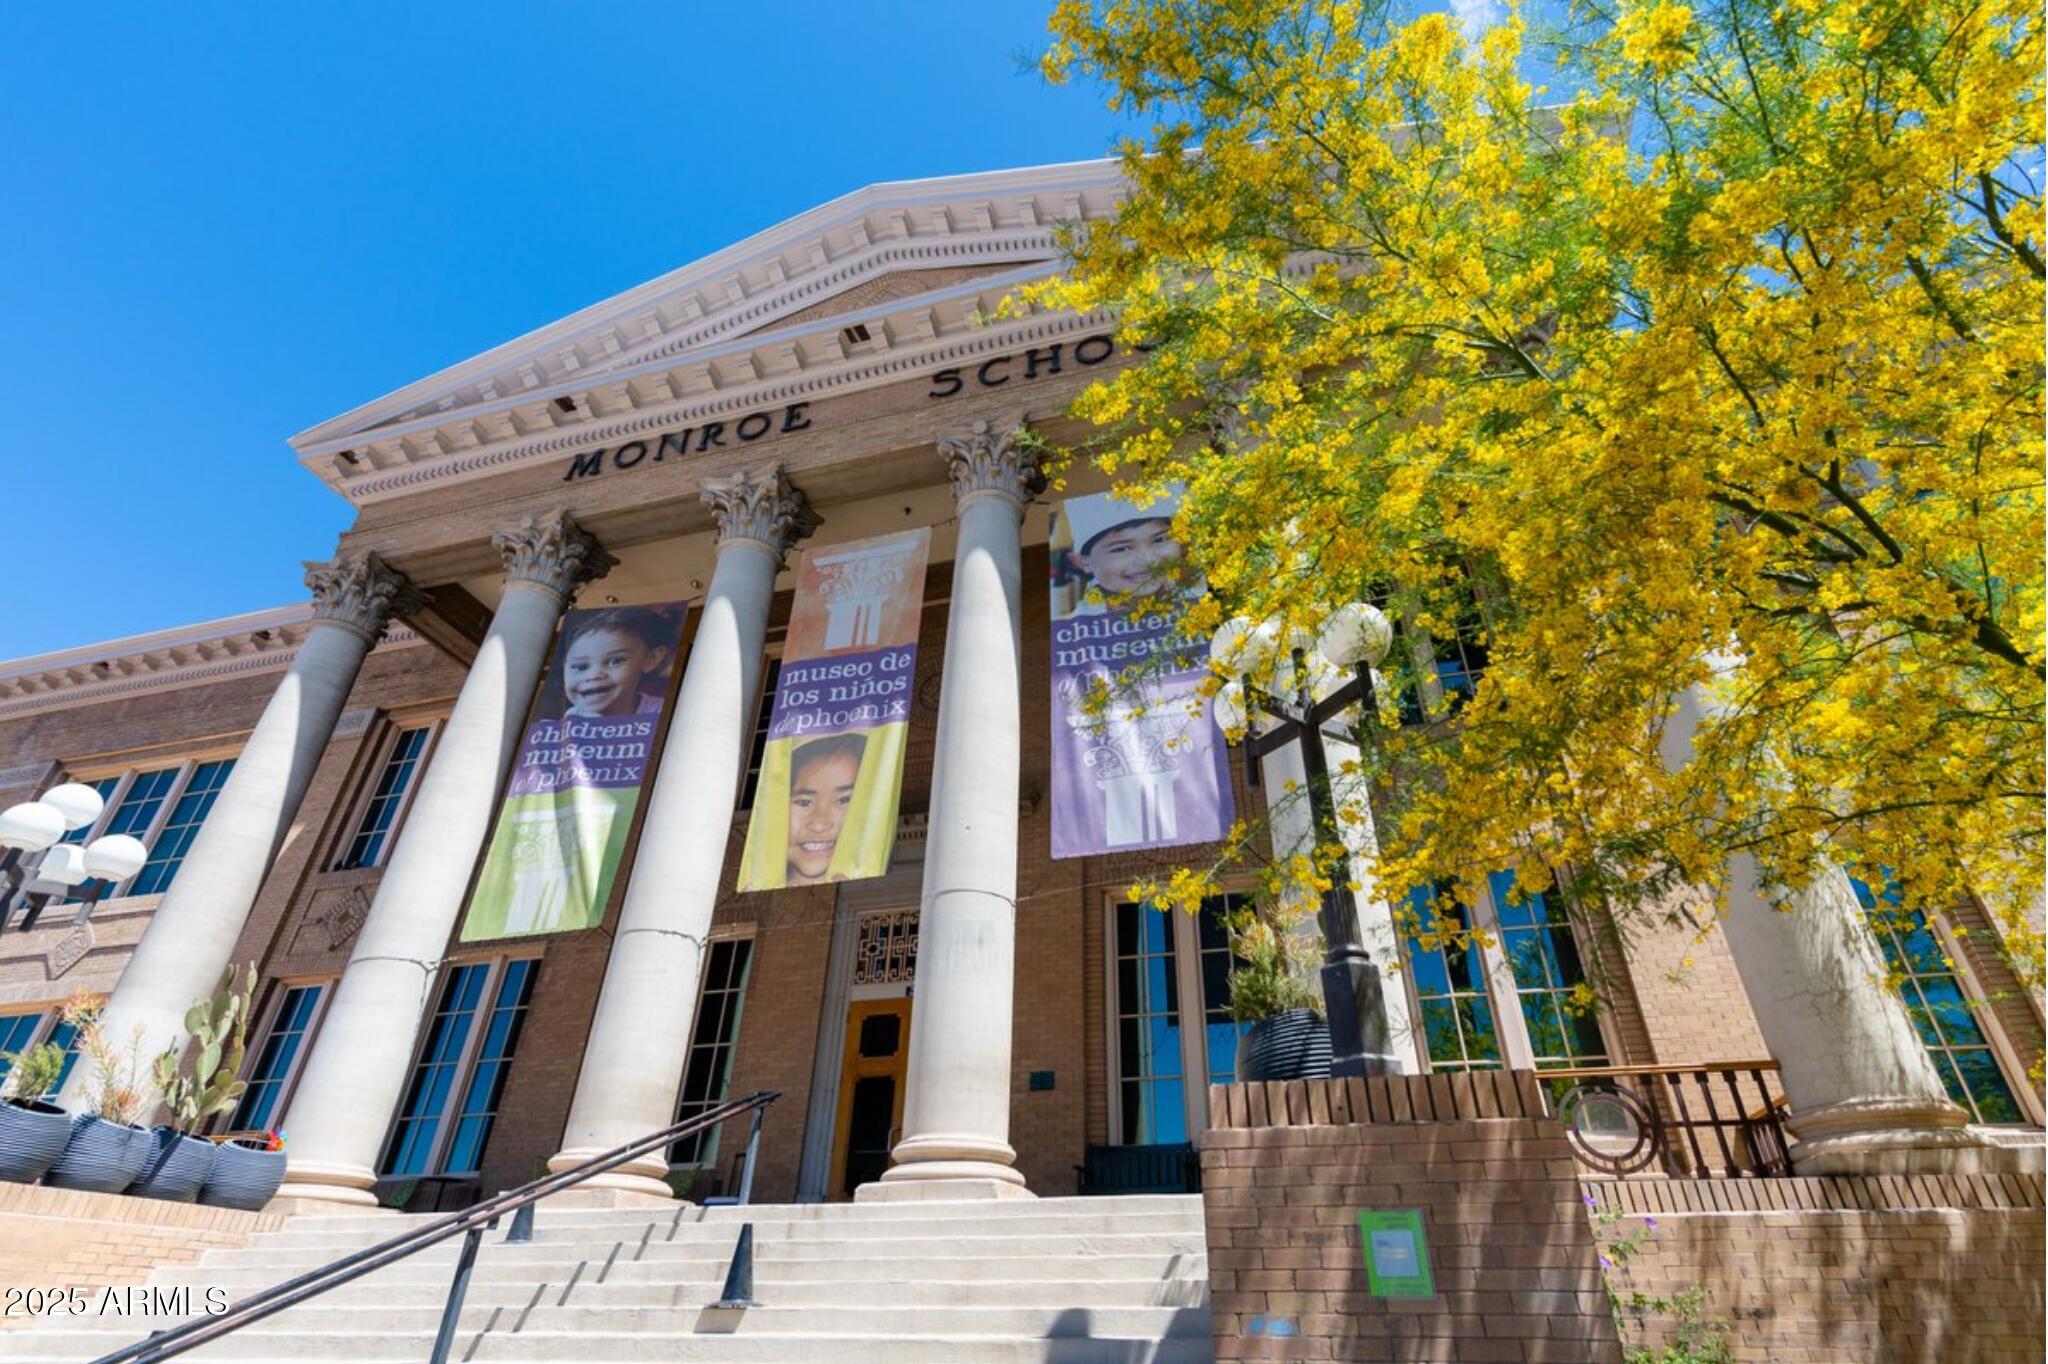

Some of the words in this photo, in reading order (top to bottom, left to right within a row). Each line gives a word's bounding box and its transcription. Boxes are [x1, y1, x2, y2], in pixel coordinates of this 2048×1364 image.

[563, 401, 812, 481] MONROE
[929, 330, 1171, 398] SCHO
[783, 661, 873, 686] museo
[880, 652, 911, 671] de
[779, 689, 819, 709] los
[828, 675, 907, 702] niños
[530, 721, 651, 744] children's
[774, 710, 796, 734] de
[796, 699, 906, 734] phoenix
[523, 743, 645, 767] museum
[515, 769, 541, 793] of
[535, 763, 641, 792] phoenix
